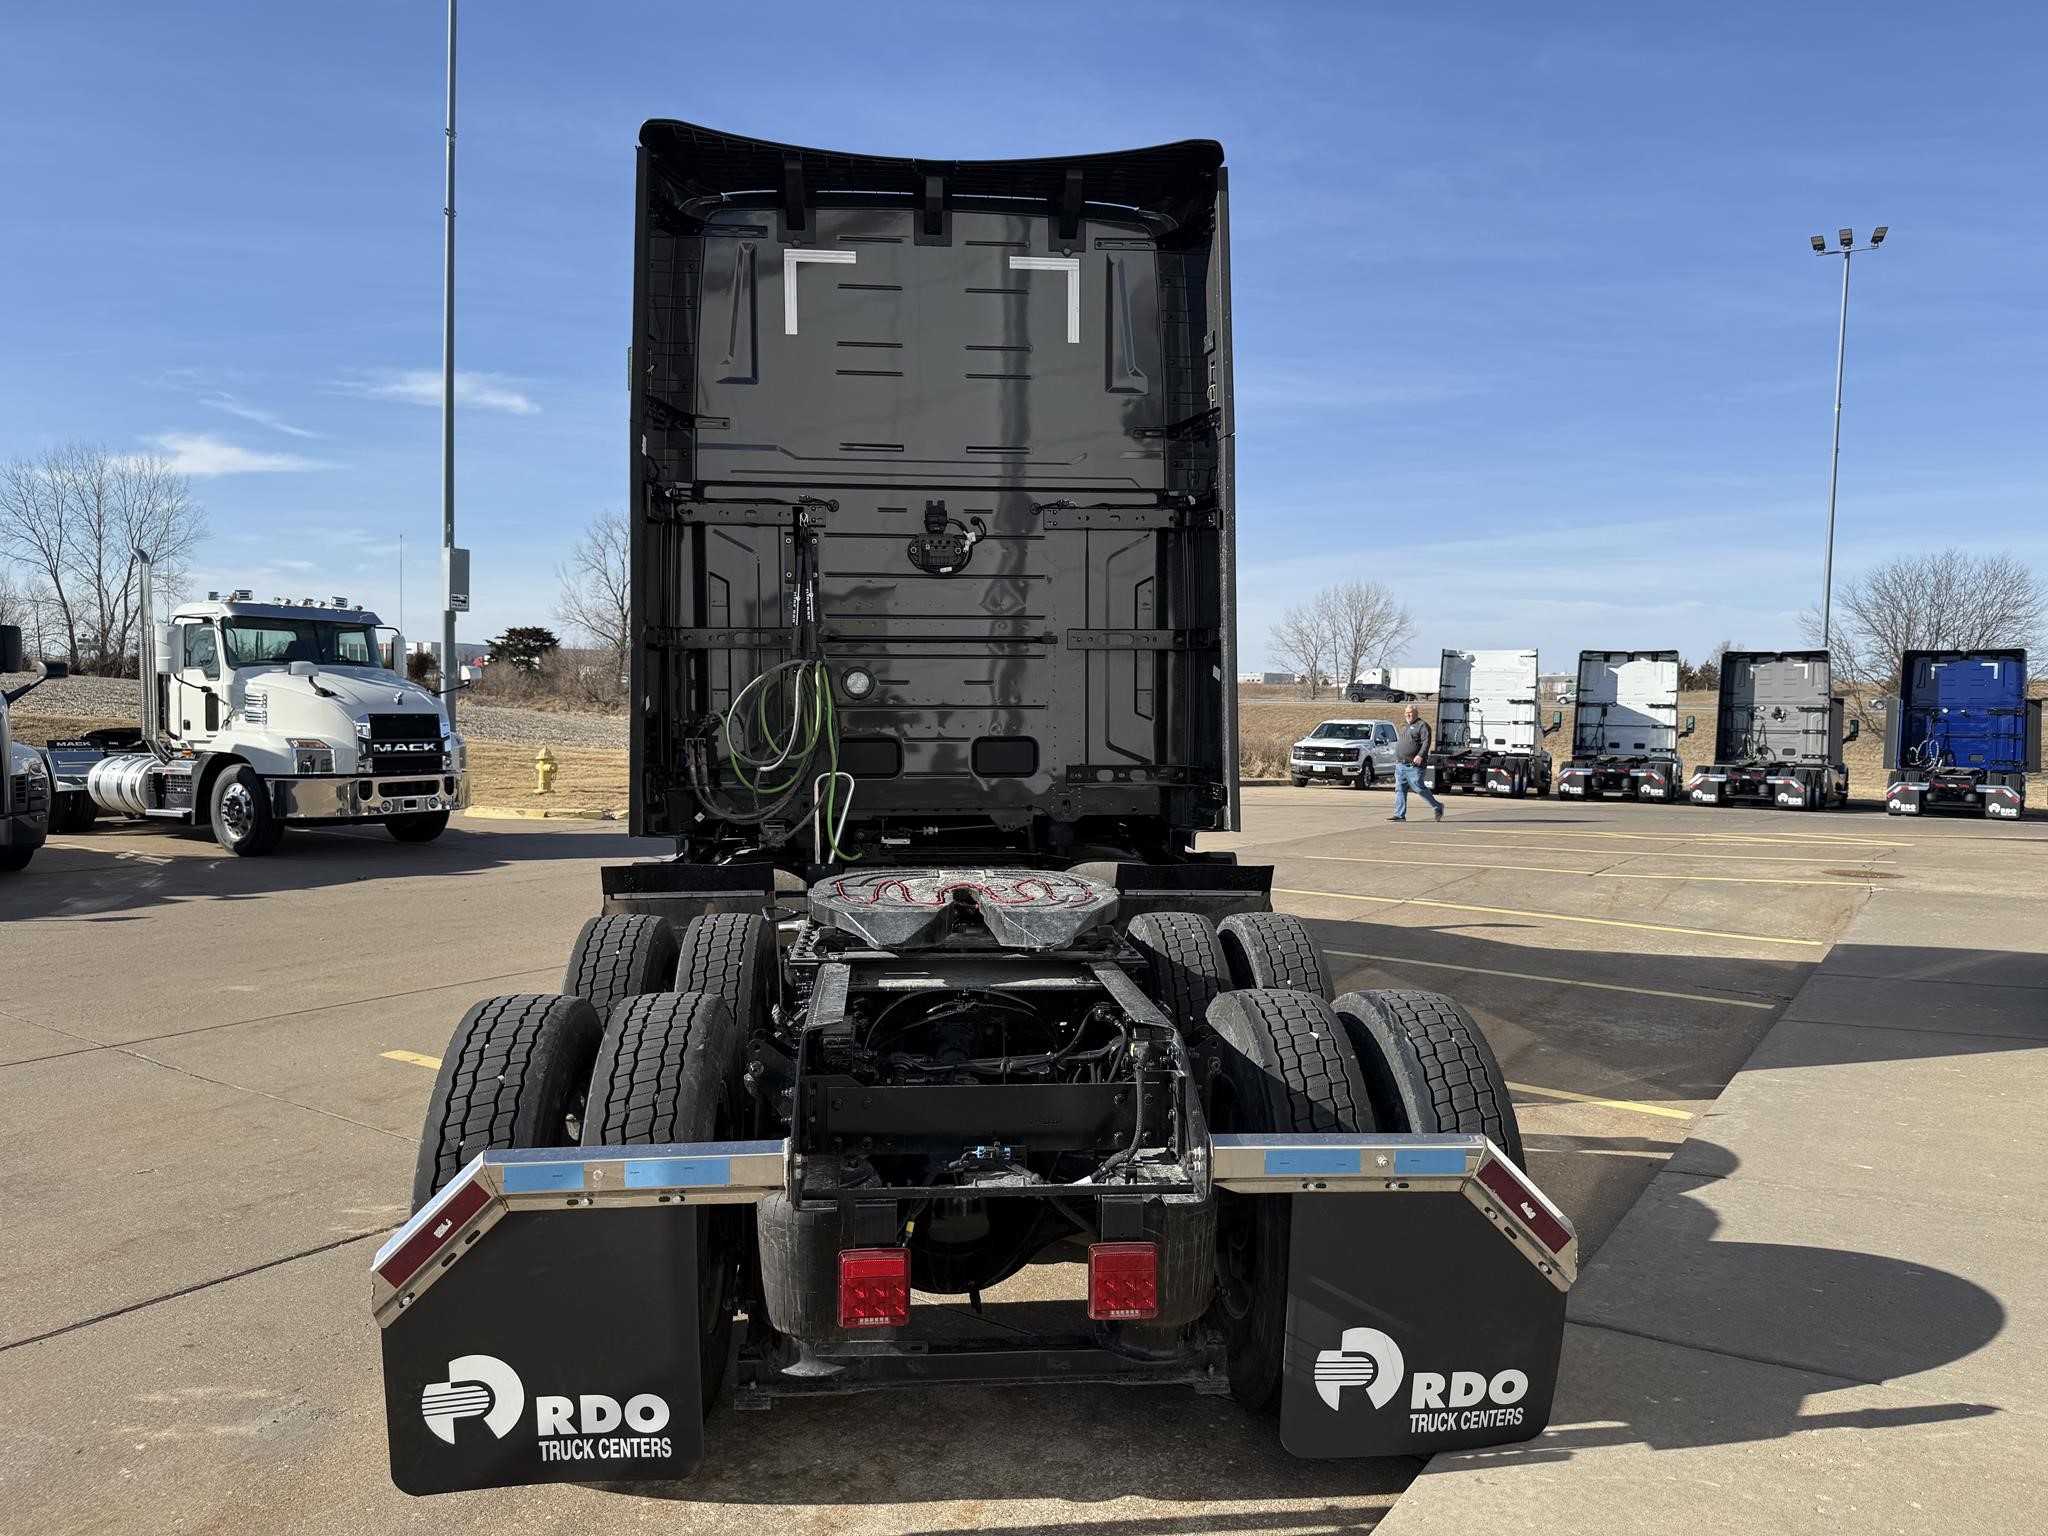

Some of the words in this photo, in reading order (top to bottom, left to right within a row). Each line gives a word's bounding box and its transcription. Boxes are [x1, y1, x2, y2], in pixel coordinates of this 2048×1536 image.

[373, 743, 437, 752] MACK
[1410, 1368, 1529, 1410] RDO
[536, 1393, 670, 1436] RDO
[1409, 1412, 1459, 1433] TRUCK
[1460, 1407, 1524, 1430] CENTERS
[538, 1438, 596, 1462] TRUCK
[598, 1437, 672, 1459] CENTERS
